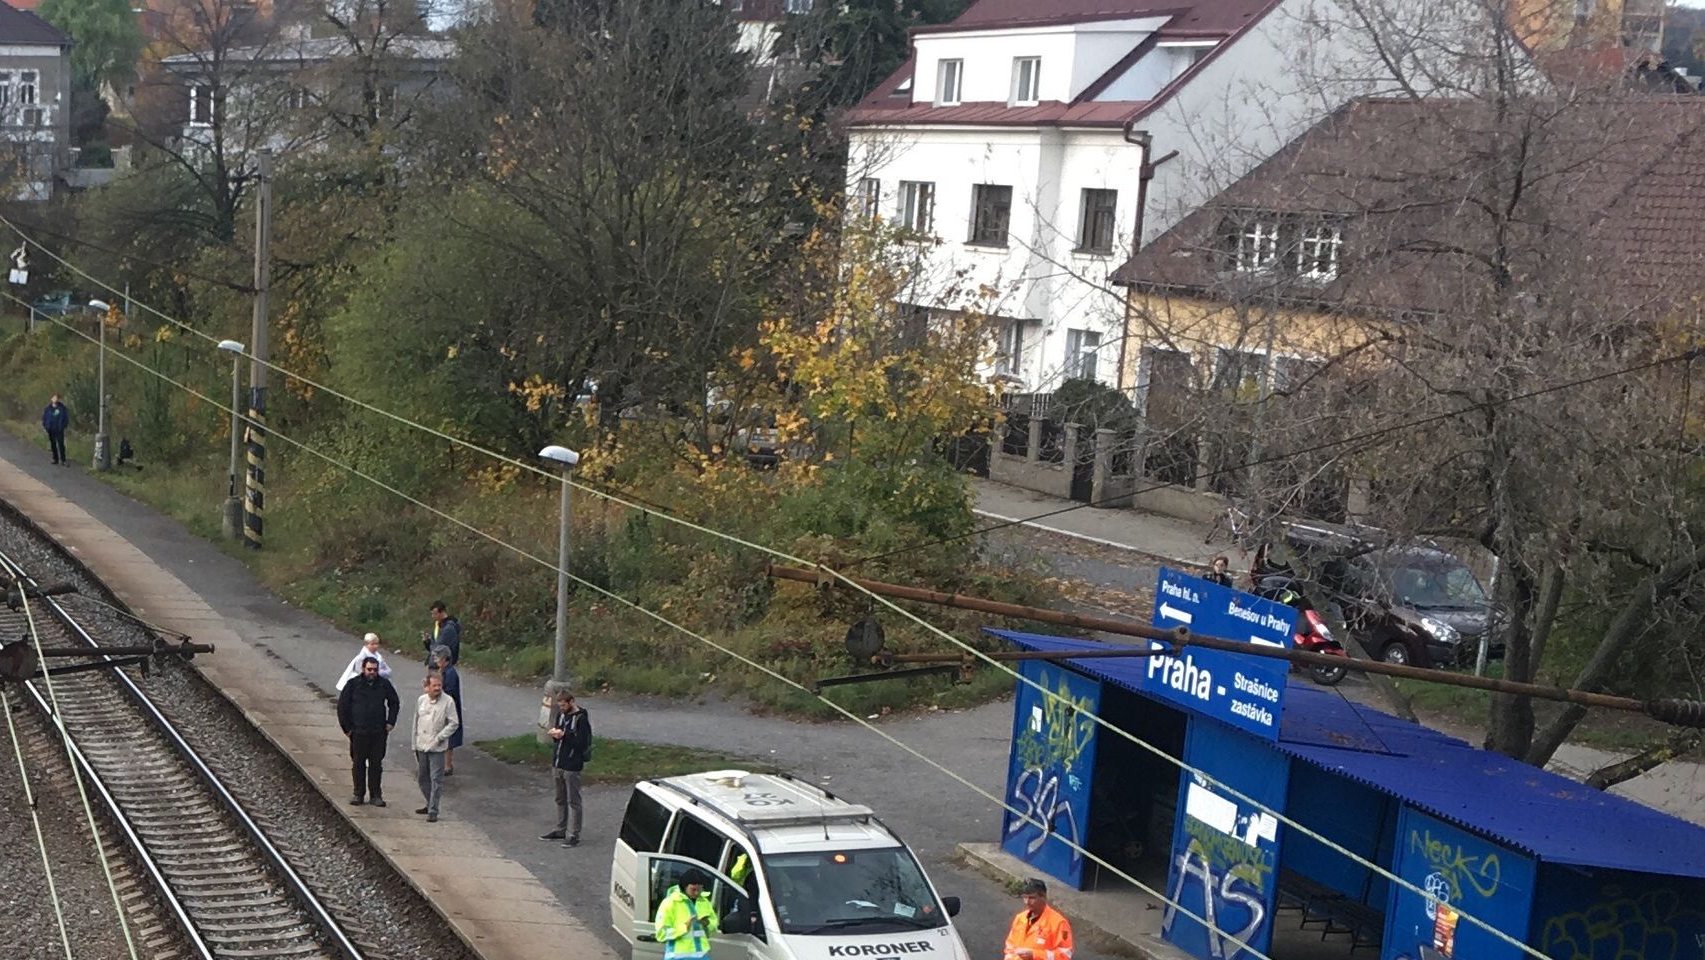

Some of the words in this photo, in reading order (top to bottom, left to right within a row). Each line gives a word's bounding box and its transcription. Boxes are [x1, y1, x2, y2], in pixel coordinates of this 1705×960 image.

[1162, 580, 1182, 598] Praha
[1228, 602, 1259, 625] Benešov
[1260, 614, 1267, 625] u
[1267, 615, 1290, 636] Prahy
[1148, 641, 1212, 700] Praha
[1234, 671, 1279, 703] Strašnice
[1230, 699, 1273, 726] zastávka
[828, 940, 935, 957] KORONER
